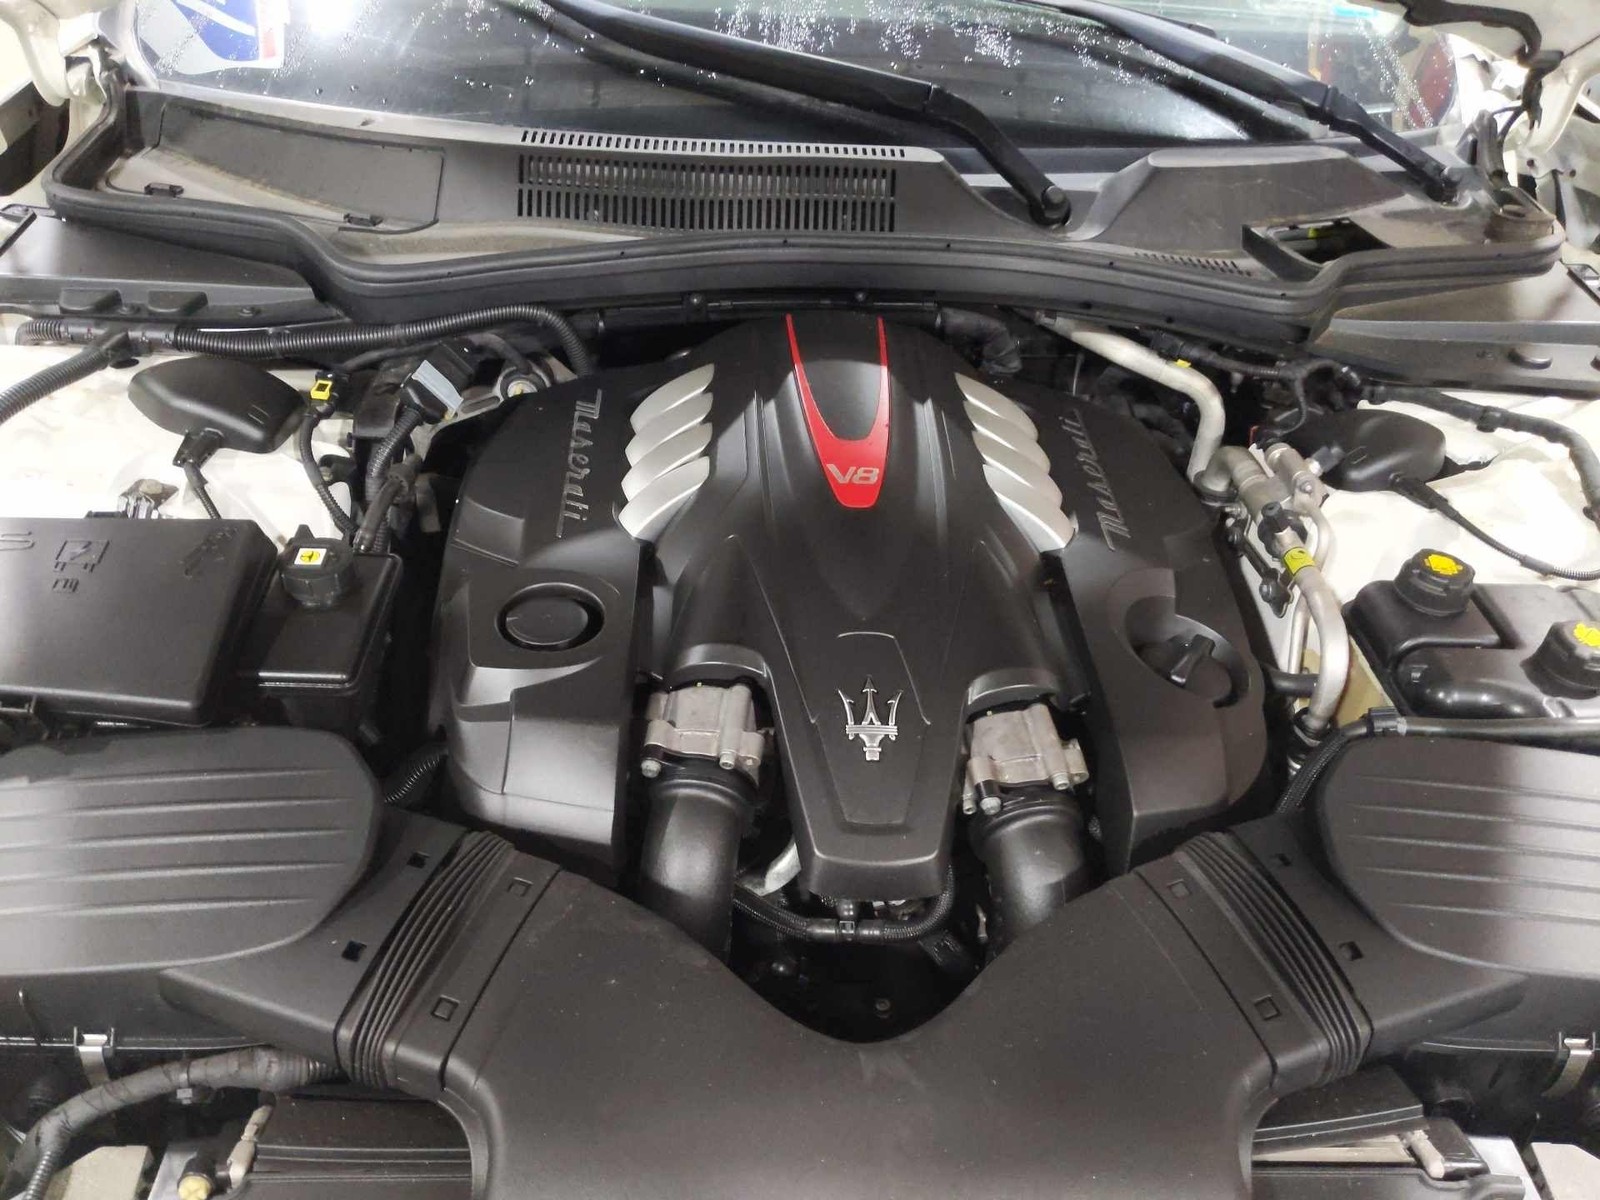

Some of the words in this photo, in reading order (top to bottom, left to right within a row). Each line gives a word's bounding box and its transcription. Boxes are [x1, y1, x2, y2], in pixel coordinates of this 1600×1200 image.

[556, 388, 603, 538] Maserati
[826, 463, 880, 485] V8
[1058, 408, 1132, 551] Maserati
